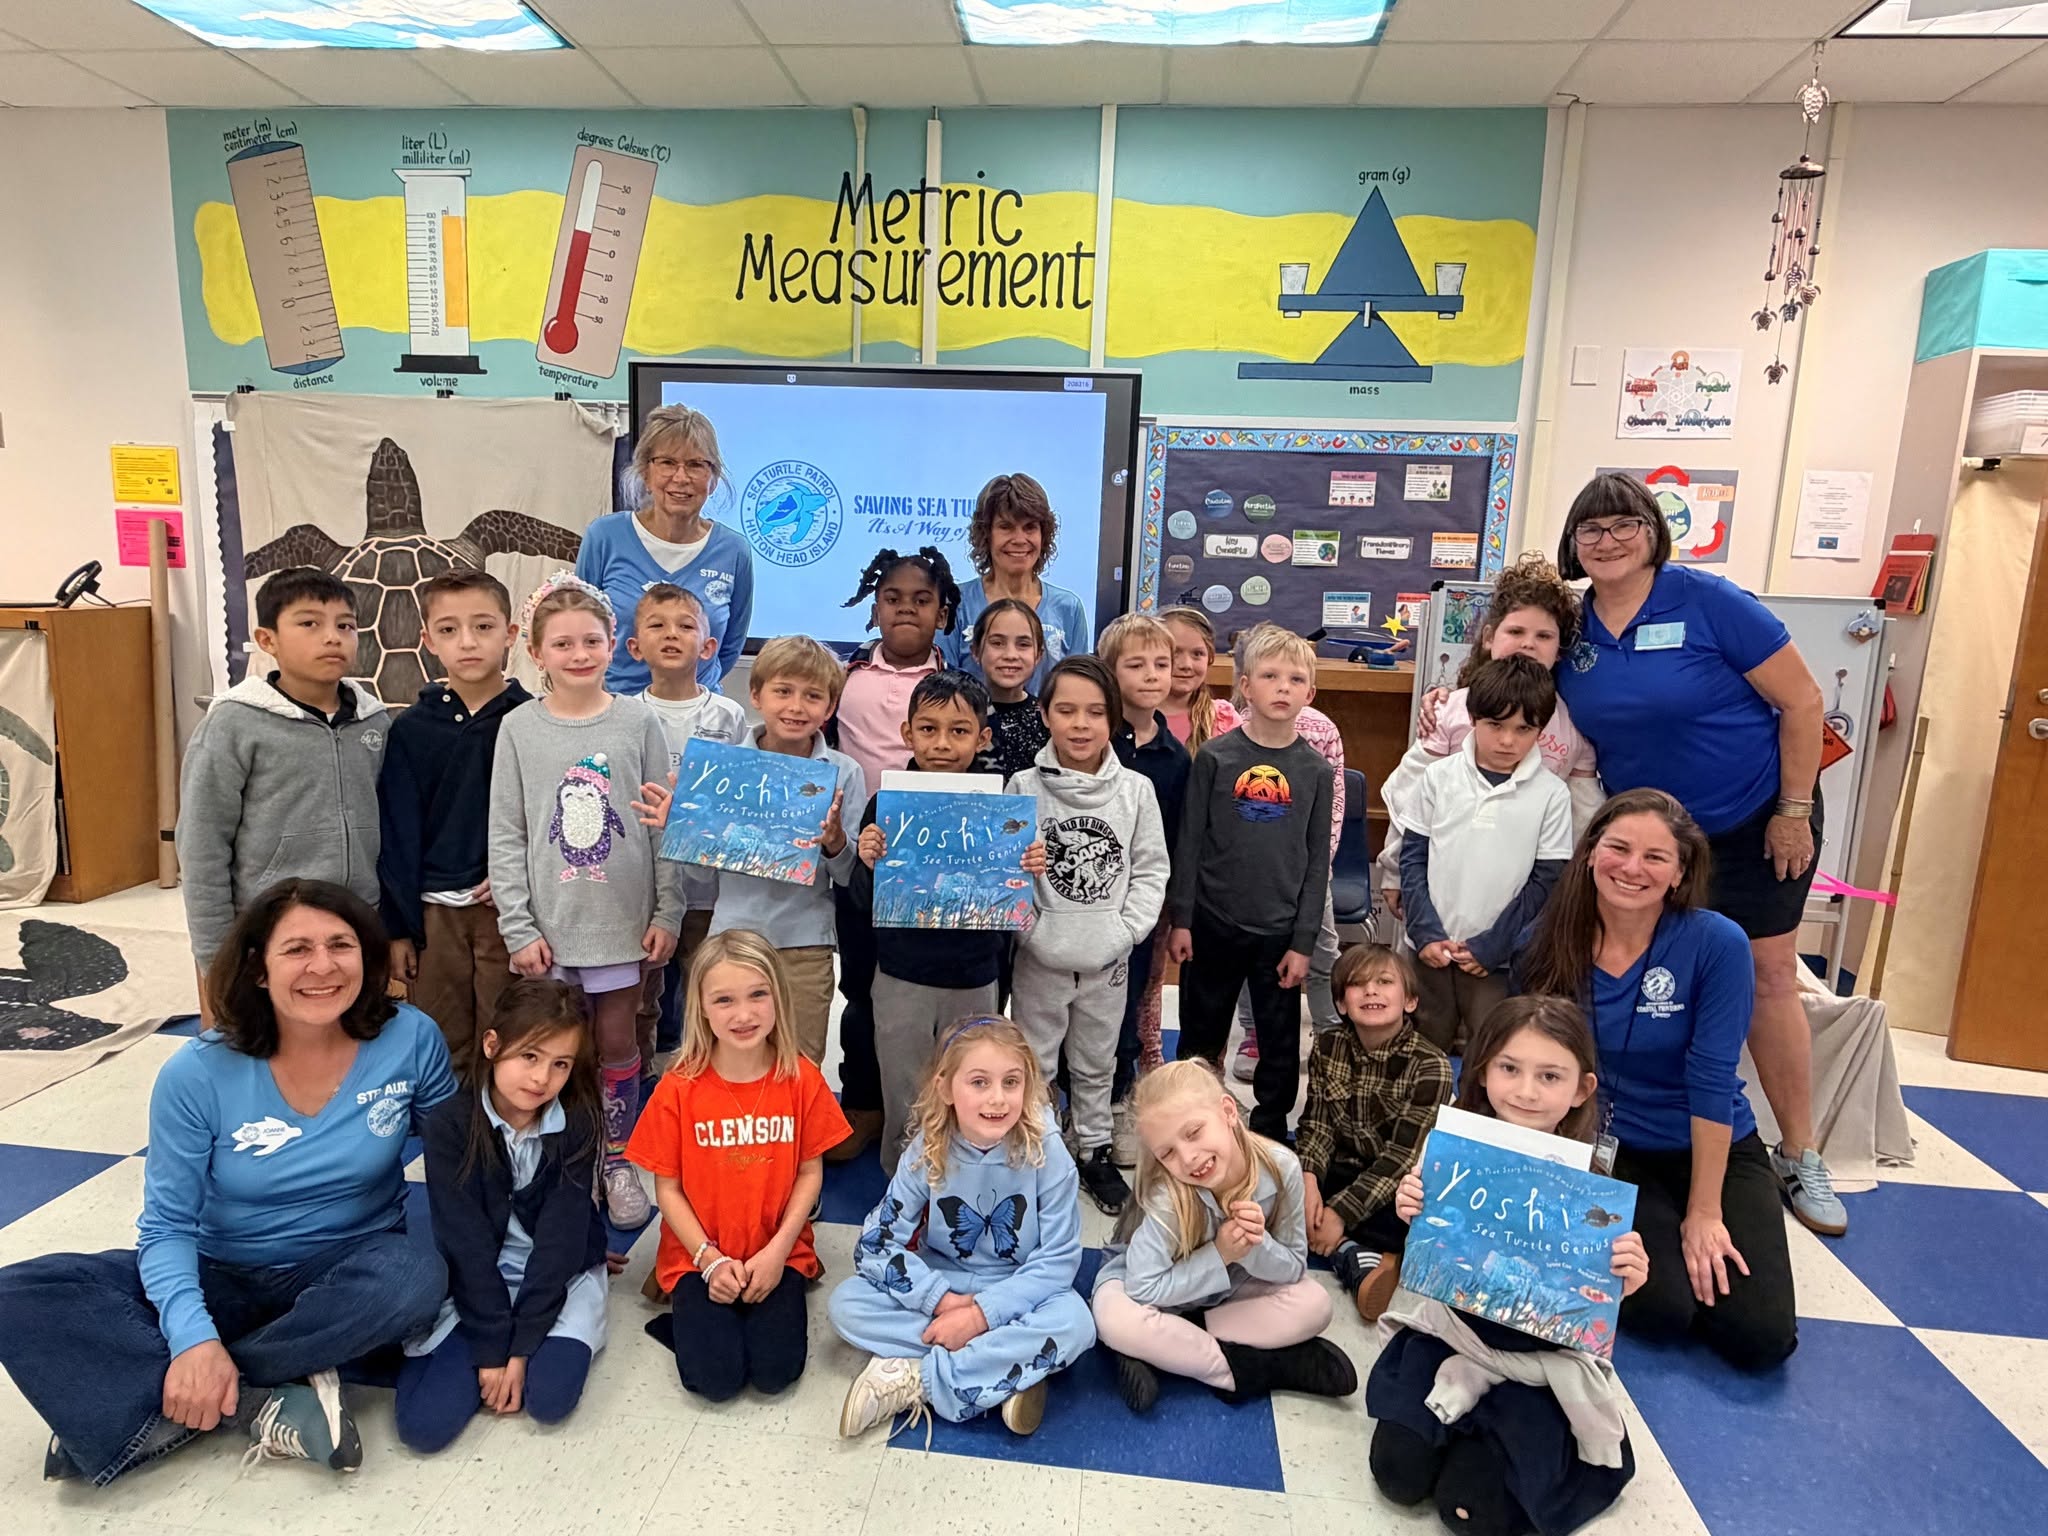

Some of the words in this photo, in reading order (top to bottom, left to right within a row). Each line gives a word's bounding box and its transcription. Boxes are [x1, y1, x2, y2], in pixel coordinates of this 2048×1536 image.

[223, 126, 251, 142] meter
[254, 117, 271, 134] (m)
[224, 133, 272, 152] centimeter
[276, 120, 298, 139] (cm)
[402, 135, 425, 150] liter
[428, 132, 448, 150] (L)
[576, 126, 615, 148] degrees
[617, 135, 650, 158] Celsius
[402, 149, 446, 164] milliliter
[449, 148, 471, 165] (ml)
[1358, 170, 1389, 186] gram
[1392, 166, 1412, 186] (g)
[829, 169, 1024, 248] Metric
[735, 232, 1097, 311] Measurement
[293, 373, 335, 390] distance
[420, 375, 459, 388] volume
[537, 365, 600, 391] temperature
[1349, 384, 1380, 396] mass
[1695, 380, 1731, 393] Predict
[1626, 415, 1667, 426] Observe
[1675, 415, 1731, 428] Investigate
[747, 478, 766, 500] SEA
[763, 464, 802, 482] TURTLE
[804, 468, 836, 504] PATROL
[854, 494, 913, 517] SAVING
[917, 496, 948, 518] SEA
[745, 519, 775, 558] HILTON
[776, 551, 808, 565] HEAD
[809, 521, 839, 559] ISLAND
[914, 520, 959, 543] Way
[700, 568, 718, 579] STP
[690, 760, 790, 808] Yoshi
[740, 806, 775, 819] Turtle
[781, 803, 817, 818] Genius
[891, 811, 993, 853] Yoshi
[946, 854, 983, 865] Turtle
[988, 839, 1023, 861] Genius
[384, 1079, 410, 1098] AUX
[694, 1115, 795, 1148] CLEMSON
[1436, 1161, 1570, 1233] Yoshi
[1471, 1222, 1496, 1239] Sea
[1504, 1231, 1552, 1252] Turtle
[1561, 1238, 1609, 1255] Genius
